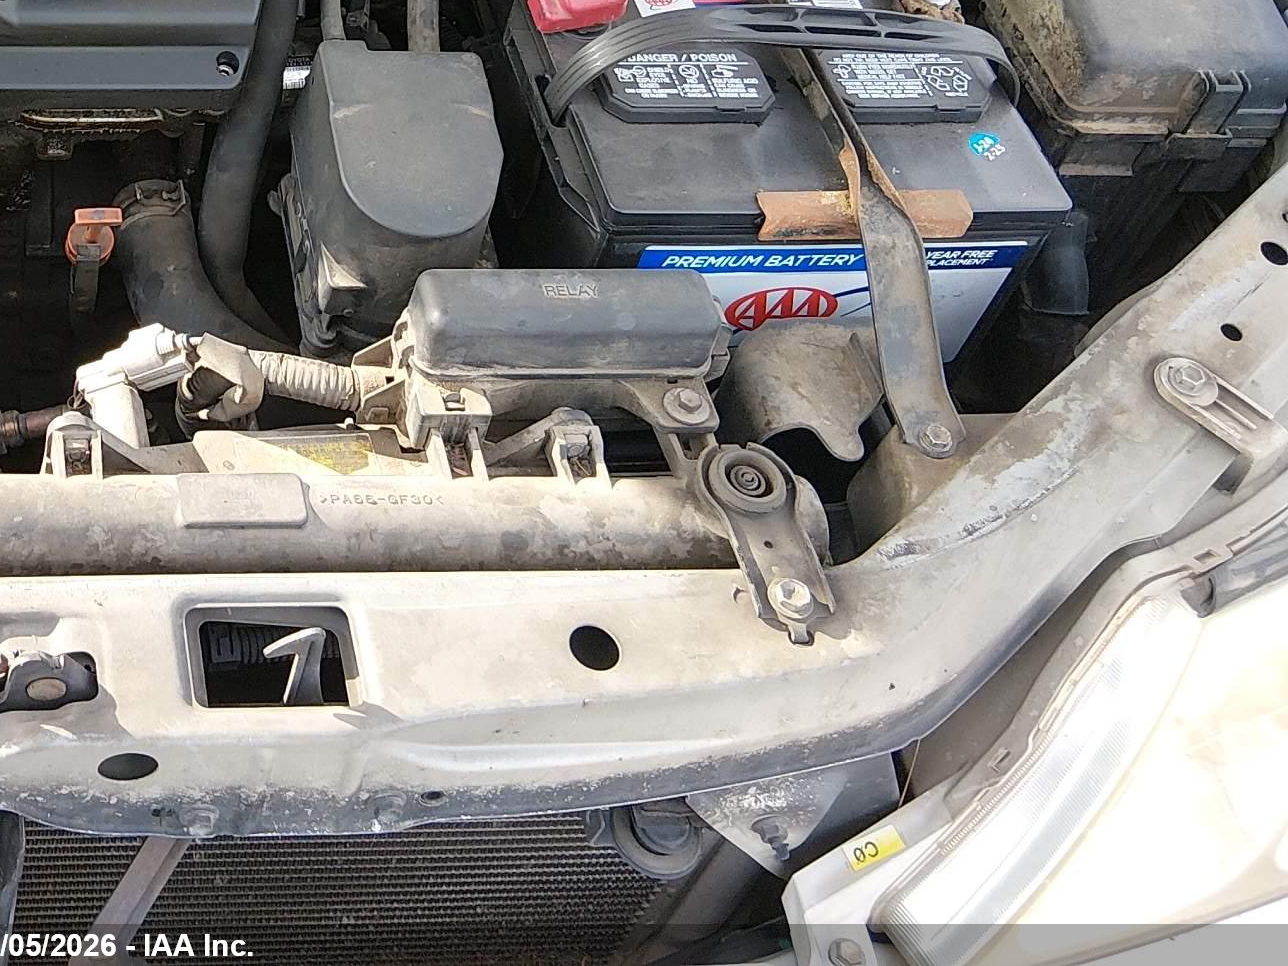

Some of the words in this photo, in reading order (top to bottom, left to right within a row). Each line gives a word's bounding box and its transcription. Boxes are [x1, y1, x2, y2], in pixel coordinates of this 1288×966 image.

[689, 53, 738, 62] POISON
[960, 249, 998, 259] FREE
[661, 255, 763, 268] PREMIUM
[764, 253, 864, 267] BATTERY
[926, 258, 990, 266] PLACEMENT
[543, 284, 598, 298] RELAY
[725, 287, 837, 331] AAA
